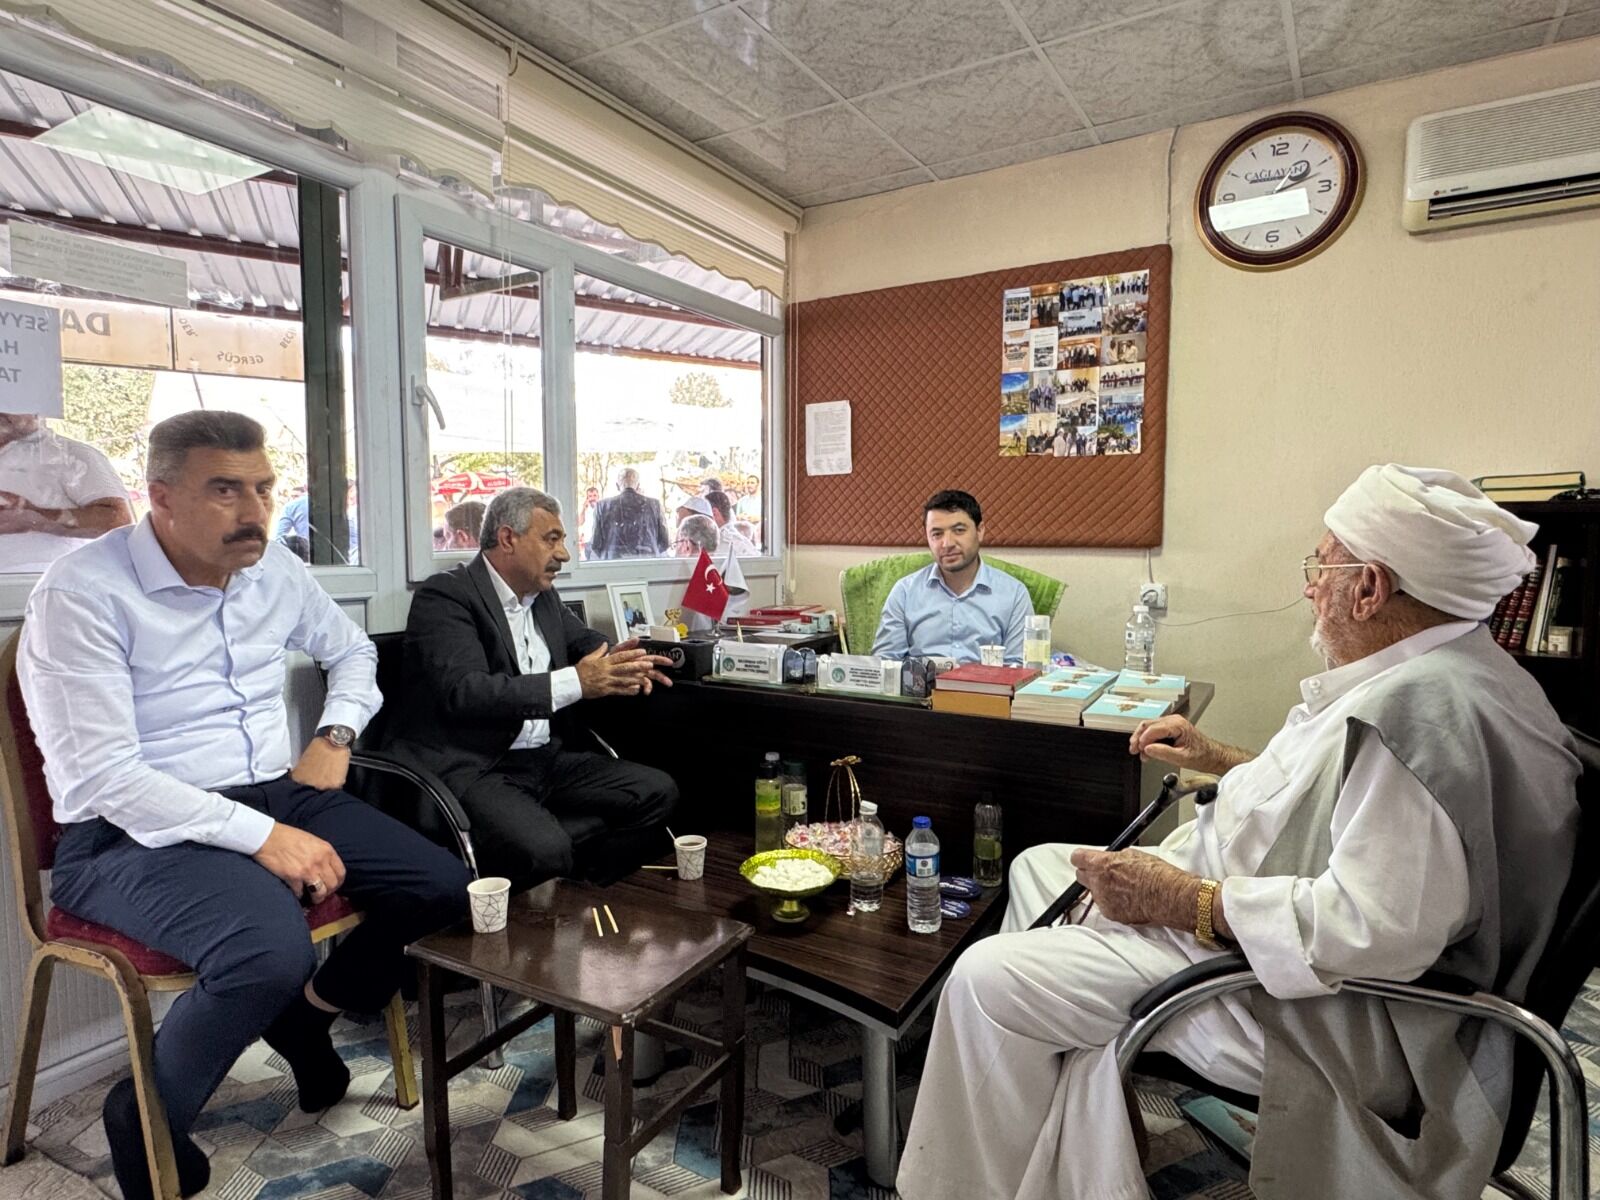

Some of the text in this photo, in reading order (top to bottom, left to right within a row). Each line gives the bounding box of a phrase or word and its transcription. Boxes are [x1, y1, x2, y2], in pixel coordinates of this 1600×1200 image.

[1269, 142, 1290, 157] 12
[1316, 179, 1332, 194] 3
[1265, 229, 1280, 244] 6
